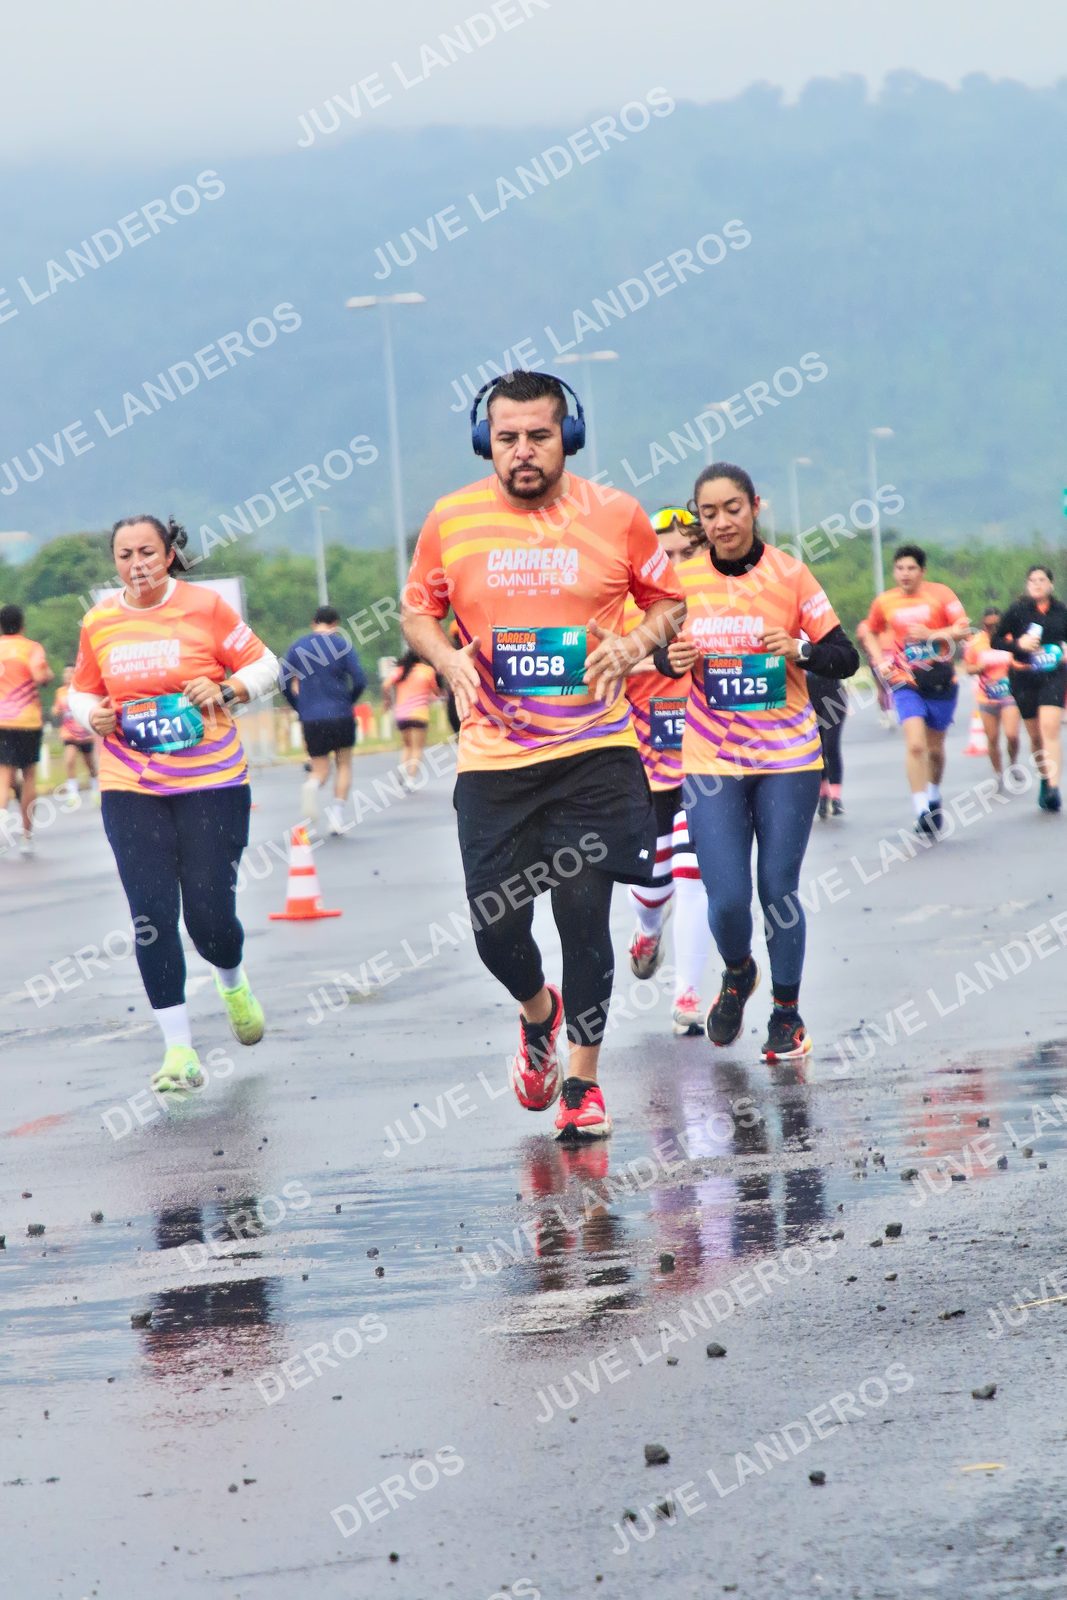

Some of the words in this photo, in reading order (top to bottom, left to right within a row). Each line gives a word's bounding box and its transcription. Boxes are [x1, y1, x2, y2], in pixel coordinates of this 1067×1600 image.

[487, 548, 579, 571] CARRERA
[691, 615, 764, 634] CARRERA
[496, 632, 537, 643] CARRERA
[562, 631, 580, 646] 10K
[110, 639, 181, 663] CARRERA
[507, 655, 565, 676] 1058
[765, 655, 780, 669] 10K
[718, 677, 768, 696] 1125
[136, 716, 183, 738] 1121
